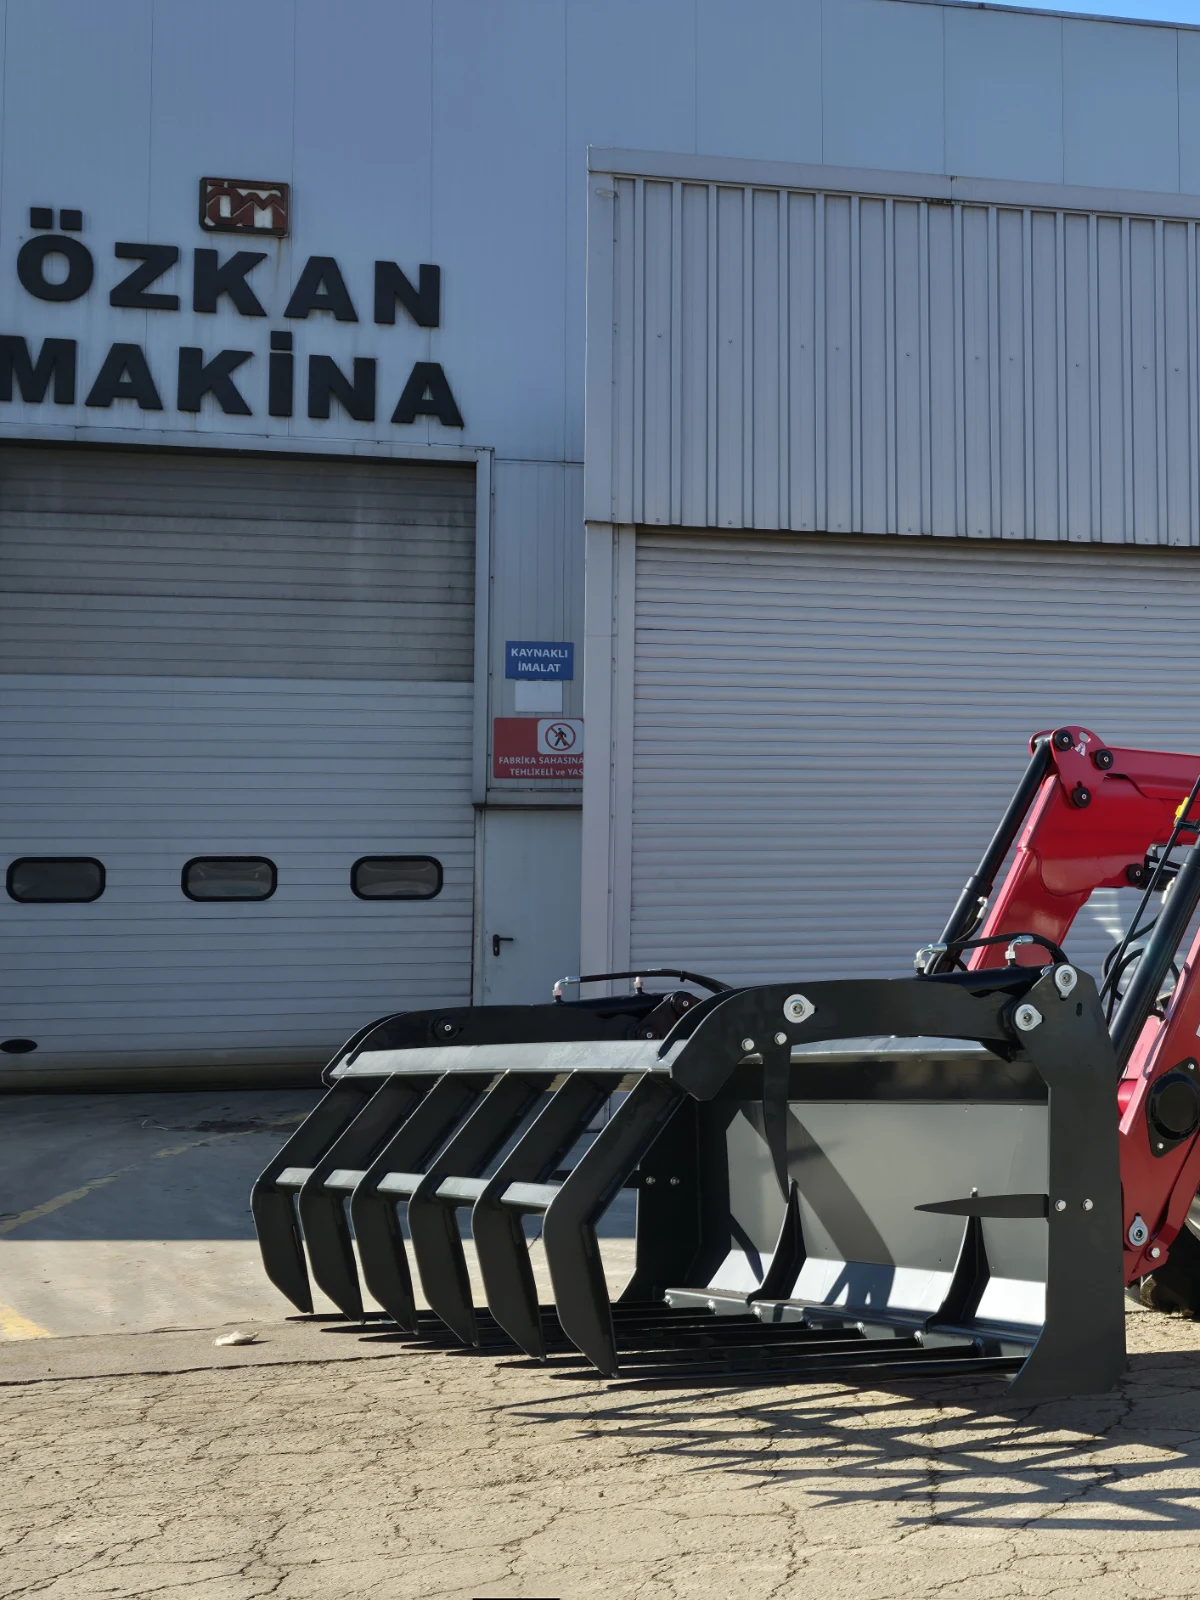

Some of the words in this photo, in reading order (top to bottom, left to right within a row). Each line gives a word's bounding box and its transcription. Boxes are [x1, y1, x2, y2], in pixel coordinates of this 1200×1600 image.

[16, 207, 441, 327] ÖZKAN
[0, 331, 465, 428] MAKİNA
[511, 648, 568, 658] KAYNAKLI
[518, 661, 561, 672] İMALAT
[499, 756, 536, 765] FABRİKA
[510, 768, 553, 776] TEHLİKELİ
